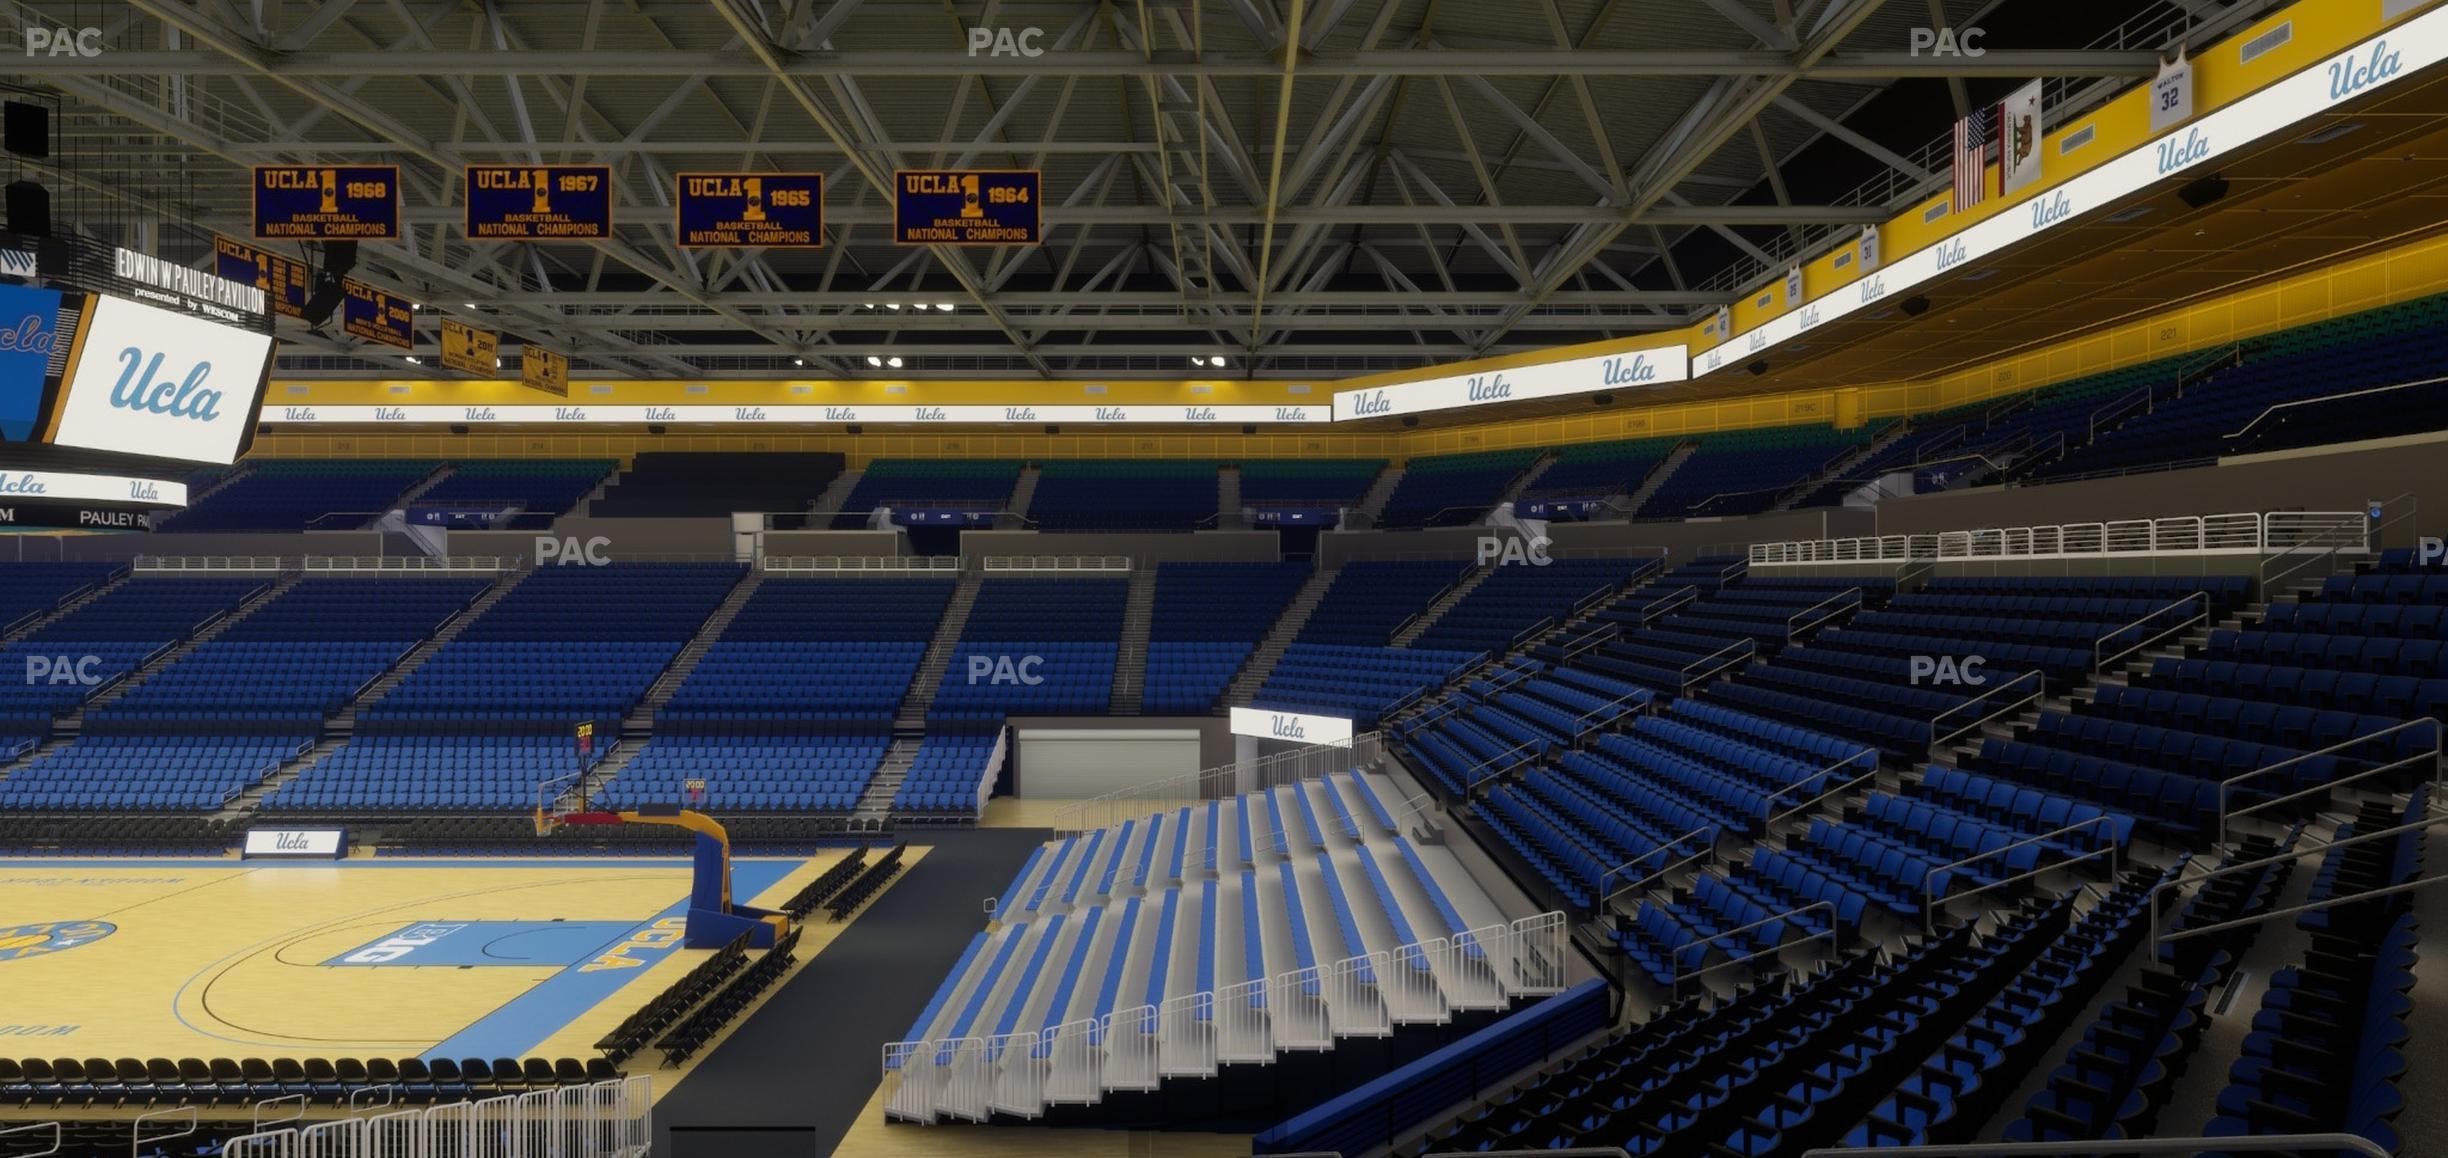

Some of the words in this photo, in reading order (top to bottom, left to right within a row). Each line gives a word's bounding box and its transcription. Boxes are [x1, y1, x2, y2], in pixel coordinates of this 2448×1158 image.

[2328, 40, 2403, 100] Ucla
[2161, 86, 2178, 111] 32
[2157, 127, 2209, 174] Ucla
[264, 170, 318, 189] UCLA
[346, 182, 386, 198] 1968
[477, 170, 531, 189] UCLA
[558, 175, 598, 192] 1967
[688, 178, 743, 197] UCLA
[770, 190, 810, 206] 1965
[906, 175, 960, 194] UCLA
[988, 187, 1029, 203] 1964
[292, 214, 359, 222] BASKETBALL
[505, 214, 571, 222] BASKETBALL
[2032, 189, 2072, 230] Ucla
[266, 223, 316, 235] NATIONAL
[324, 223, 386, 235] CHAMPIONS
[479, 223, 529, 235] NATIONAL
[537, 223, 599, 235] CHAMPIONS
[716, 222, 783, 230] BASKETBALL
[907, 228, 958, 240] NATIONAL
[966, 228, 1028, 240] CHAMPIONS
[934, 218, 1001, 227] BASKETBALL
[690, 231, 741, 243] NATIONAL
[749, 231, 810, 243] CHAMPIONS
[219, 240, 252, 262] UCLA
[1937, 237, 1967, 271] Ucla
[116, 248, 158, 285] EDWIN
[160, 260, 172, 289] W
[174, 265, 217, 301] PAULEY
[217, 277, 265, 315] PAVILION
[1860, 275, 1885, 304] Ucla
[135, 288, 180, 305] presented
[187, 299, 198, 311] by
[202, 304, 239, 322] WESCOM
[1800, 304, 1820, 329] Ucla
[2160, 327, 2177, 341] 221
[110, 347, 222, 421] Ucla
[1354, 390, 1392, 416] Ucla
[1468, 374, 1511, 401] Ucla
[1603, 355, 1656, 386] Ucla
[285, 407, 316, 421] Ucla
[374, 407, 406, 421] Ucla
[465, 407, 496, 421] Ucla
[555, 407, 586, 421] Ucla
[645, 407, 676, 421] Ucla
[735, 407, 766, 421] Ucla
[824, 407, 856, 421] Ucla
[915, 407, 946, 421] Ucla
[1006, 407, 1036, 421] Ucla
[1095, 407, 1126, 421] Ucla
[1185, 407, 1217, 421] Ucla
[1275, 407, 1307, 421] Ucla
[129, 480, 159, 501] Ucla
[79, 510, 135, 526] PAULEY
[1272, 714, 1305, 739] Ucla
[276, 832, 308, 850] Ucla
[577, 916, 688, 973] UCLA
